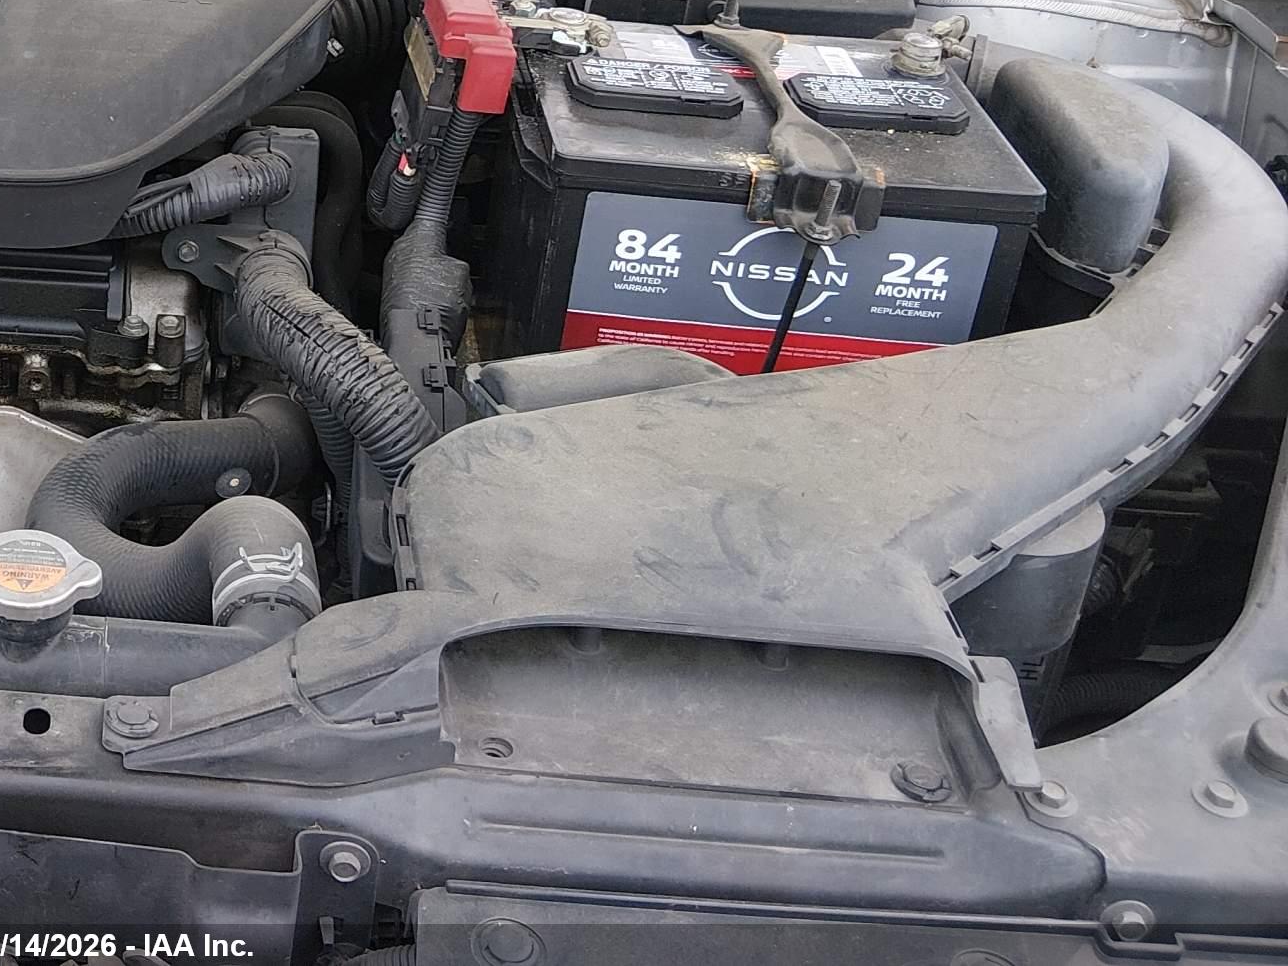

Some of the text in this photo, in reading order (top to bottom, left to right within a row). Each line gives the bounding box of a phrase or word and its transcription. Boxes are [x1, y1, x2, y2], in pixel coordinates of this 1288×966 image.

[598, 59, 650, 70] DANGER
[662, 64, 711, 73] POISON
[615, 229, 682, 264] 84
[609, 260, 679, 278] MONTH
[710, 260, 849, 287] NISSAN
[881, 252, 950, 287] 24
[623, 275, 662, 285] LIMITED
[613, 282, 668, 294] WARRANTY
[874, 284, 947, 301] MONTH
[895, 299, 921, 308] FREE
[870, 306, 943, 319] REPLACEMENT
[2, 570, 49, 580] WARNING
